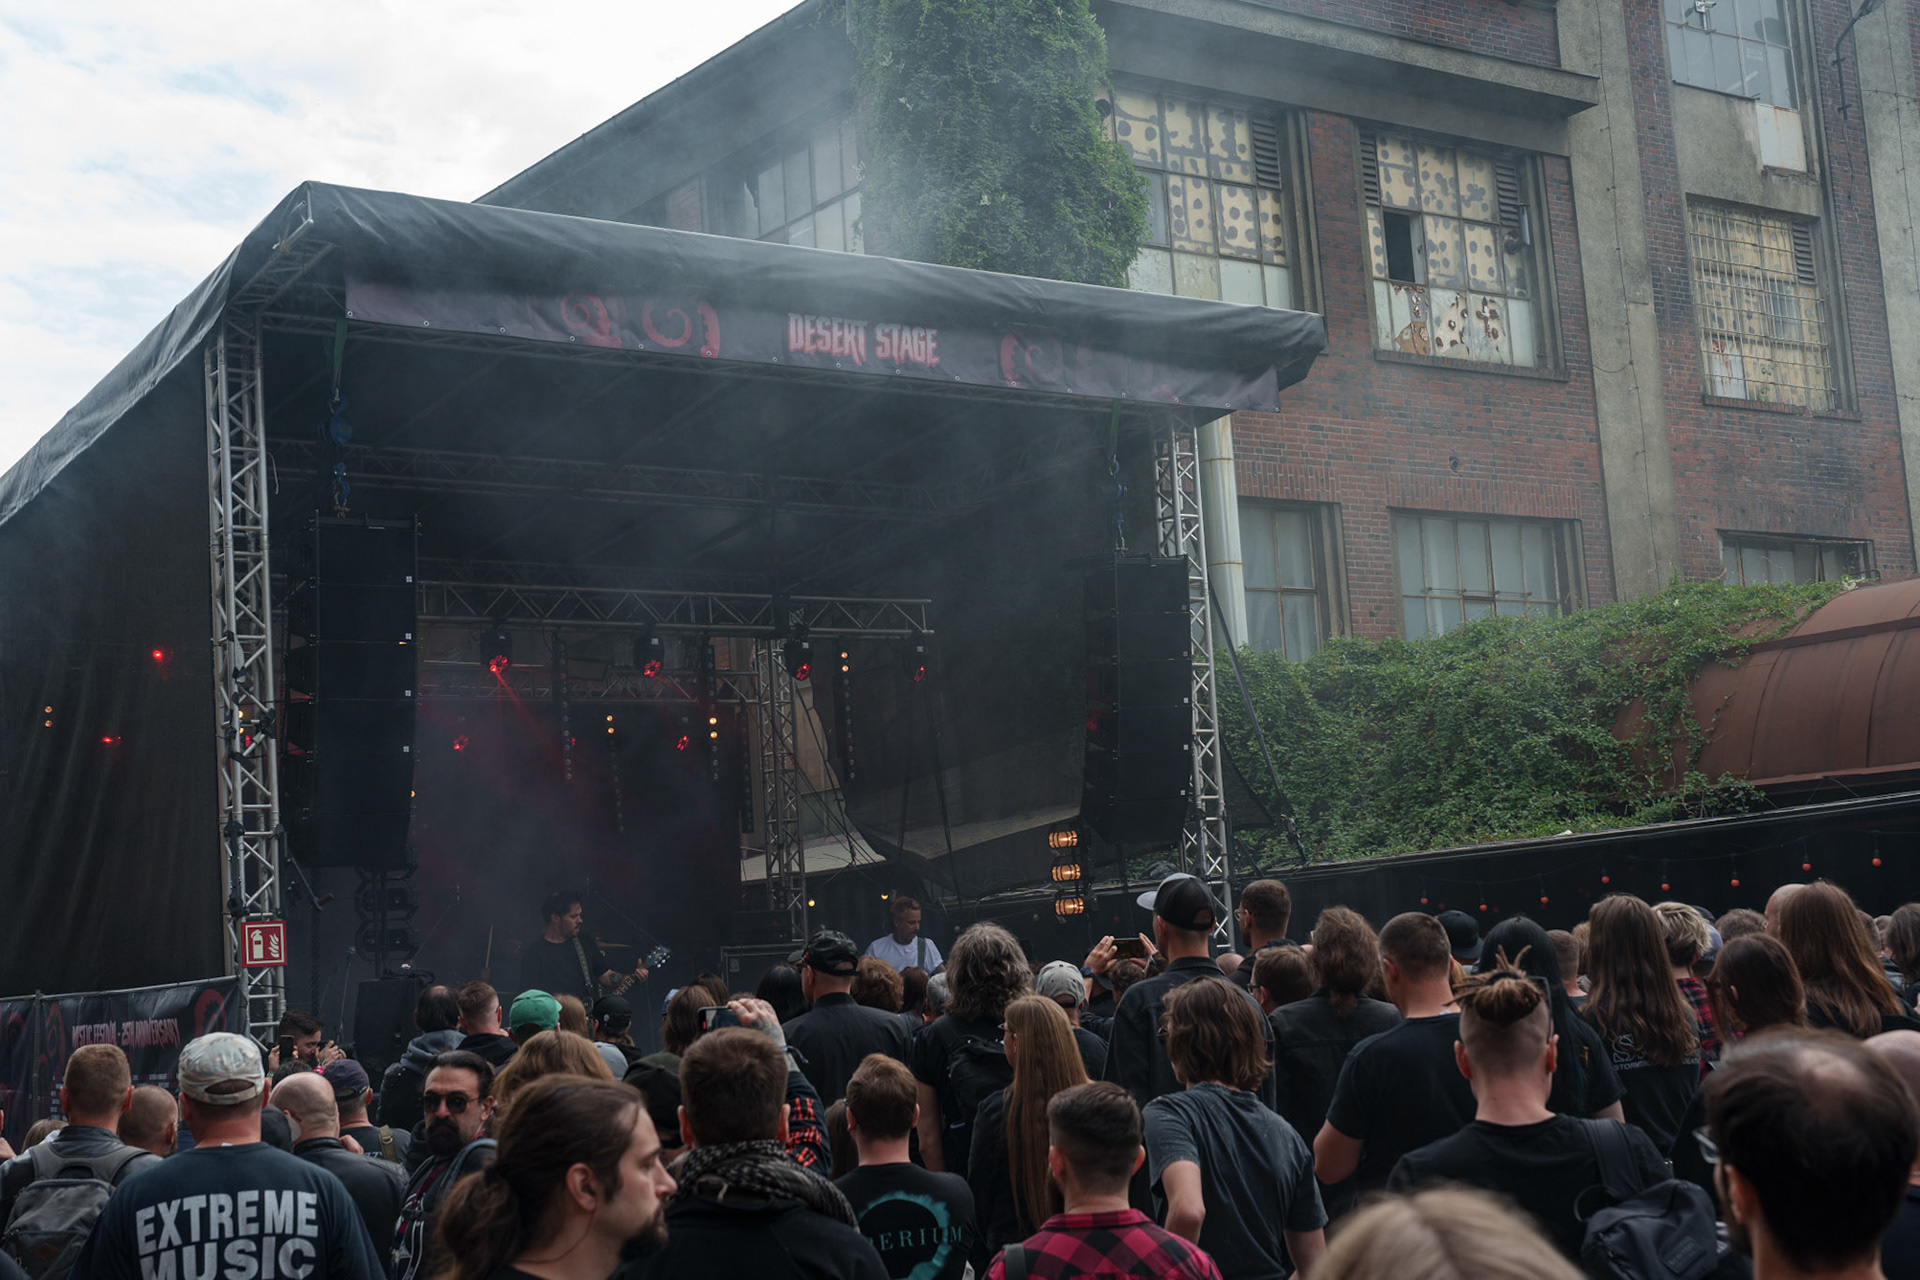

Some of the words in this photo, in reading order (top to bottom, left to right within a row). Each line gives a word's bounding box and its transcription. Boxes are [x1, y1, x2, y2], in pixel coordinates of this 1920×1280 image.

[788, 312, 868, 367] DESERT
[874, 322, 941, 367] STAGE
[135, 1017, 181, 1049] ANNIVERSARY
[135, 1189, 319, 1257] EXTREME
[139, 1236, 317, 1280] MUSIC
